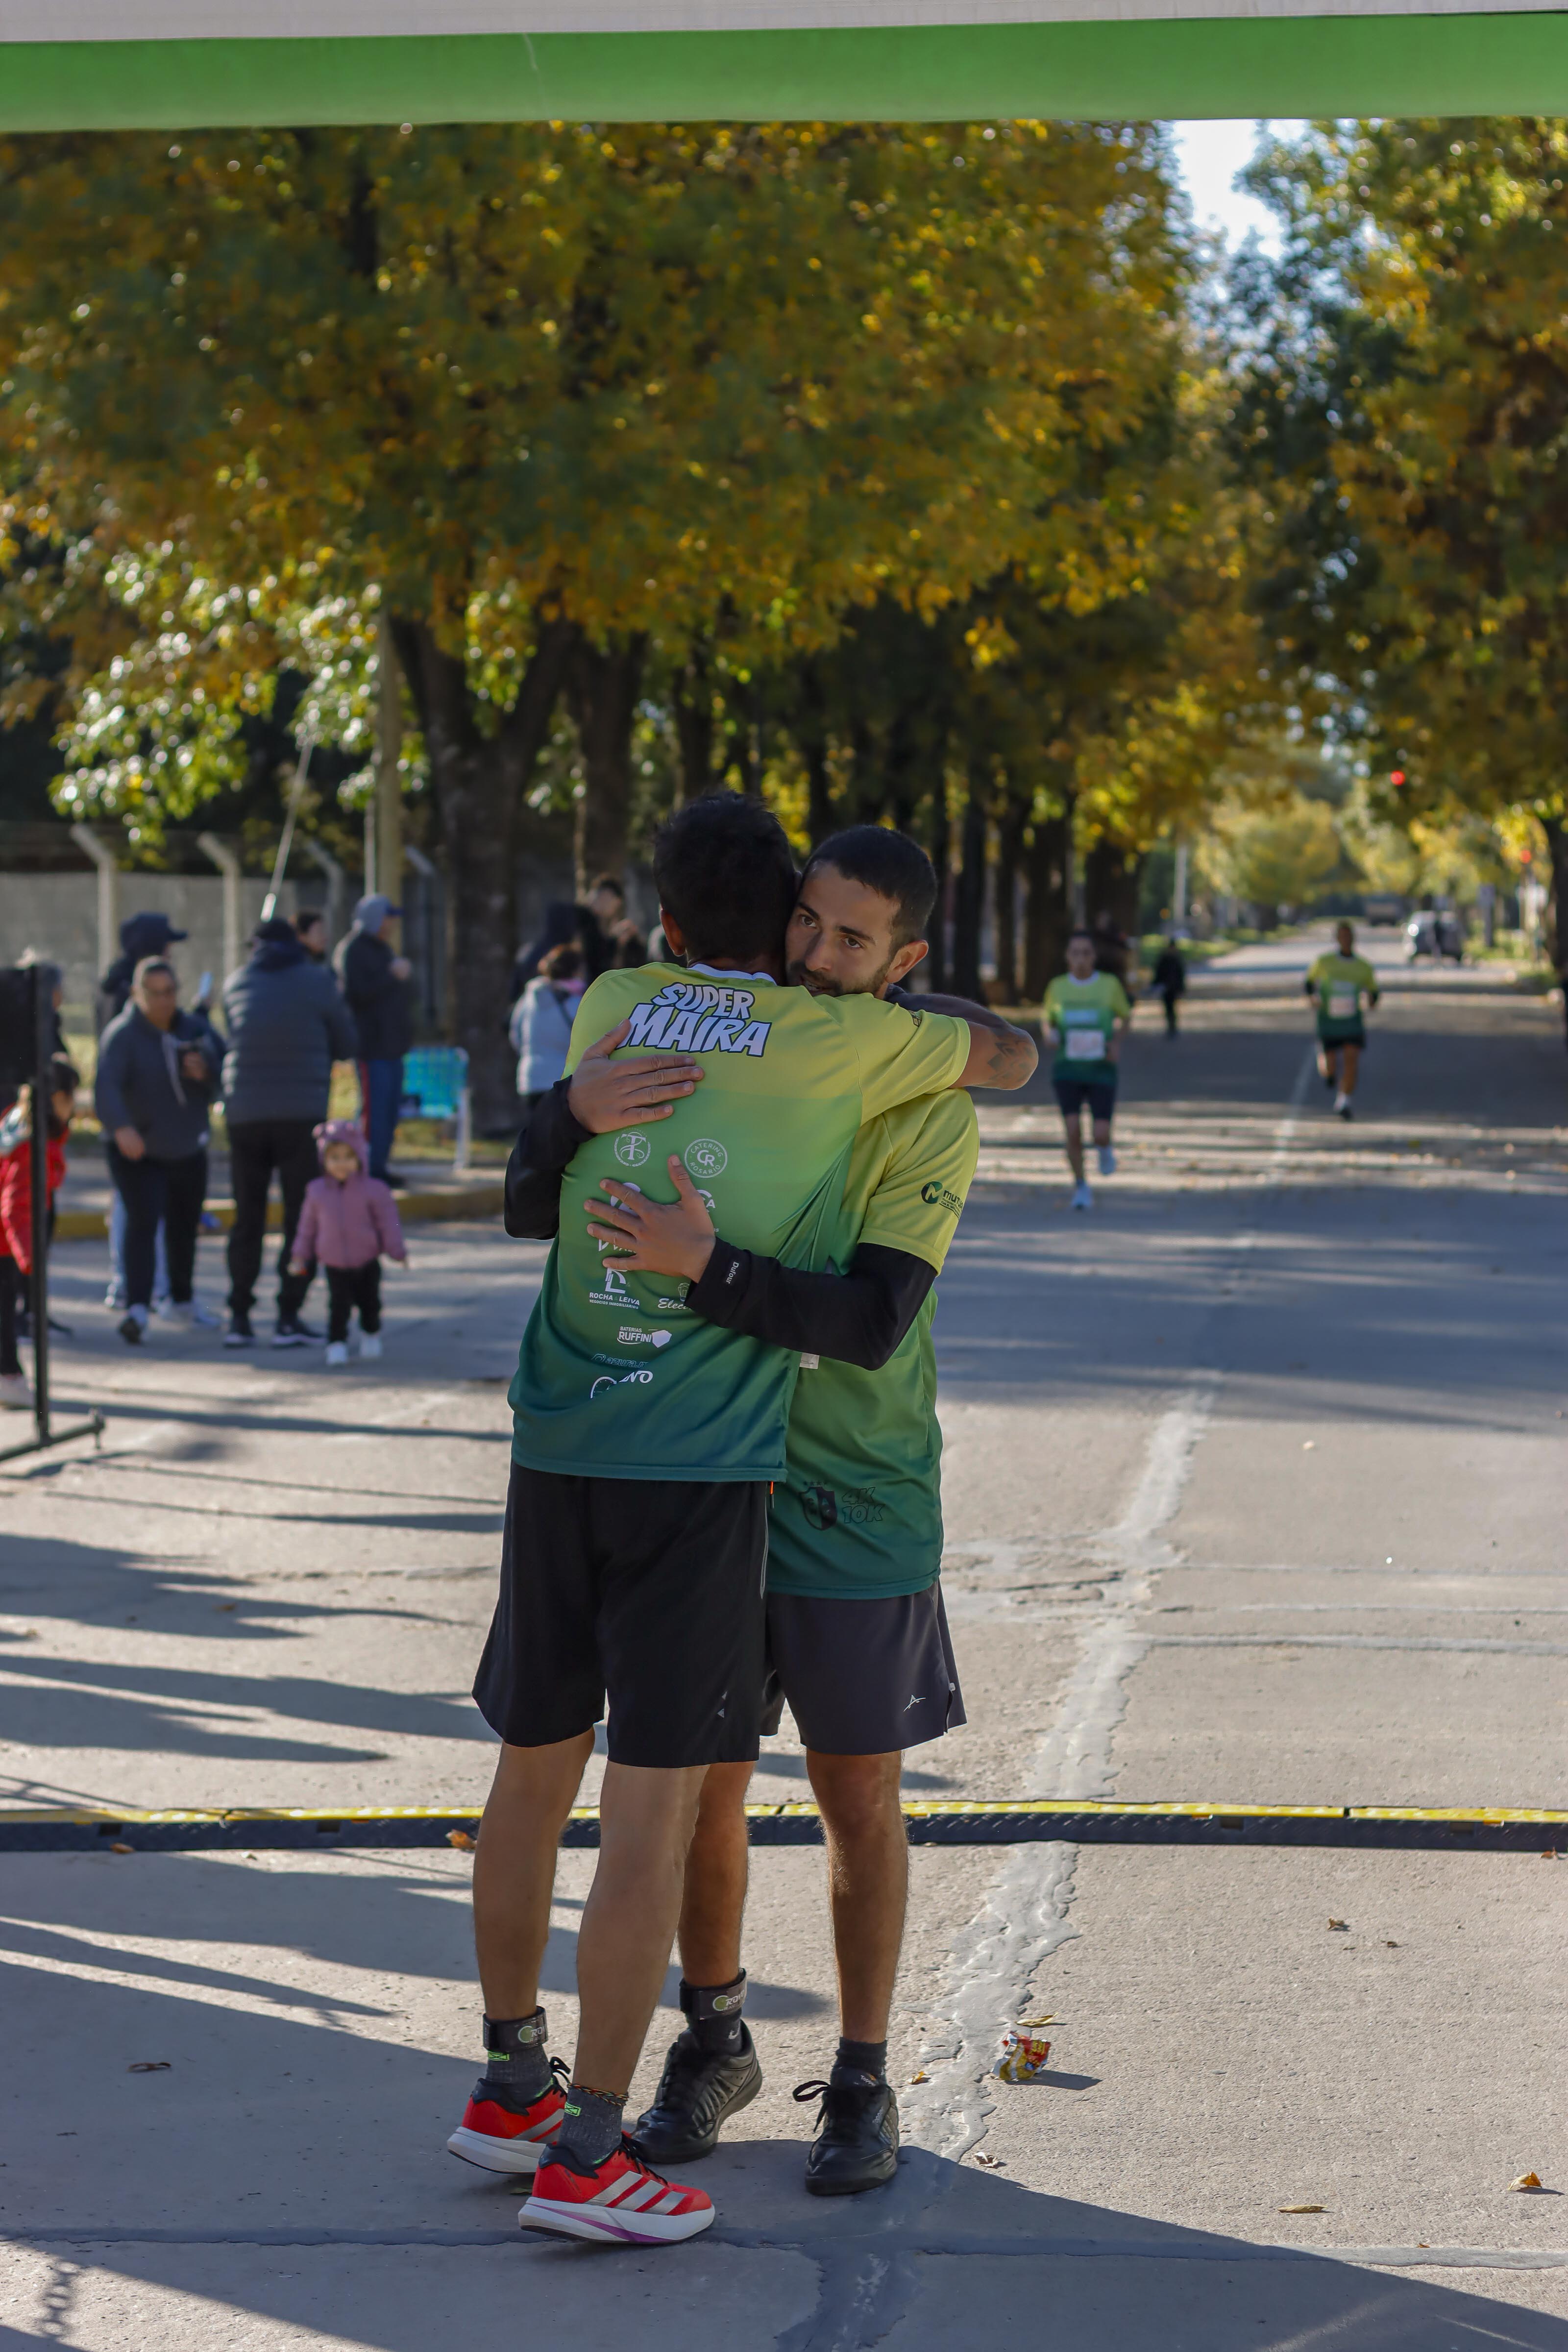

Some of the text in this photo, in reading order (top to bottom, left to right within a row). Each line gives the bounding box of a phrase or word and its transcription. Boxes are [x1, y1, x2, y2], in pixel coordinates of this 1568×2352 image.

[652, 982, 755, 1019] SUPER
[615, 1003, 772, 1057] MAIRA
[690, 1143, 724, 1157] CATERING
[697, 1150, 715, 1167] CR
[689, 1162, 721, 1175] ROSARIO
[726, 1261, 739, 1284] Dufour
[589, 1292, 640, 1305] ROCHA LEIVA
[609, 1301, 639, 1310] INMOBILIARIOS
[618, 1331, 652, 1343] RUFFINI
[842, 1487, 876, 1505] 4K
[842, 1504, 885, 1524] 10K
